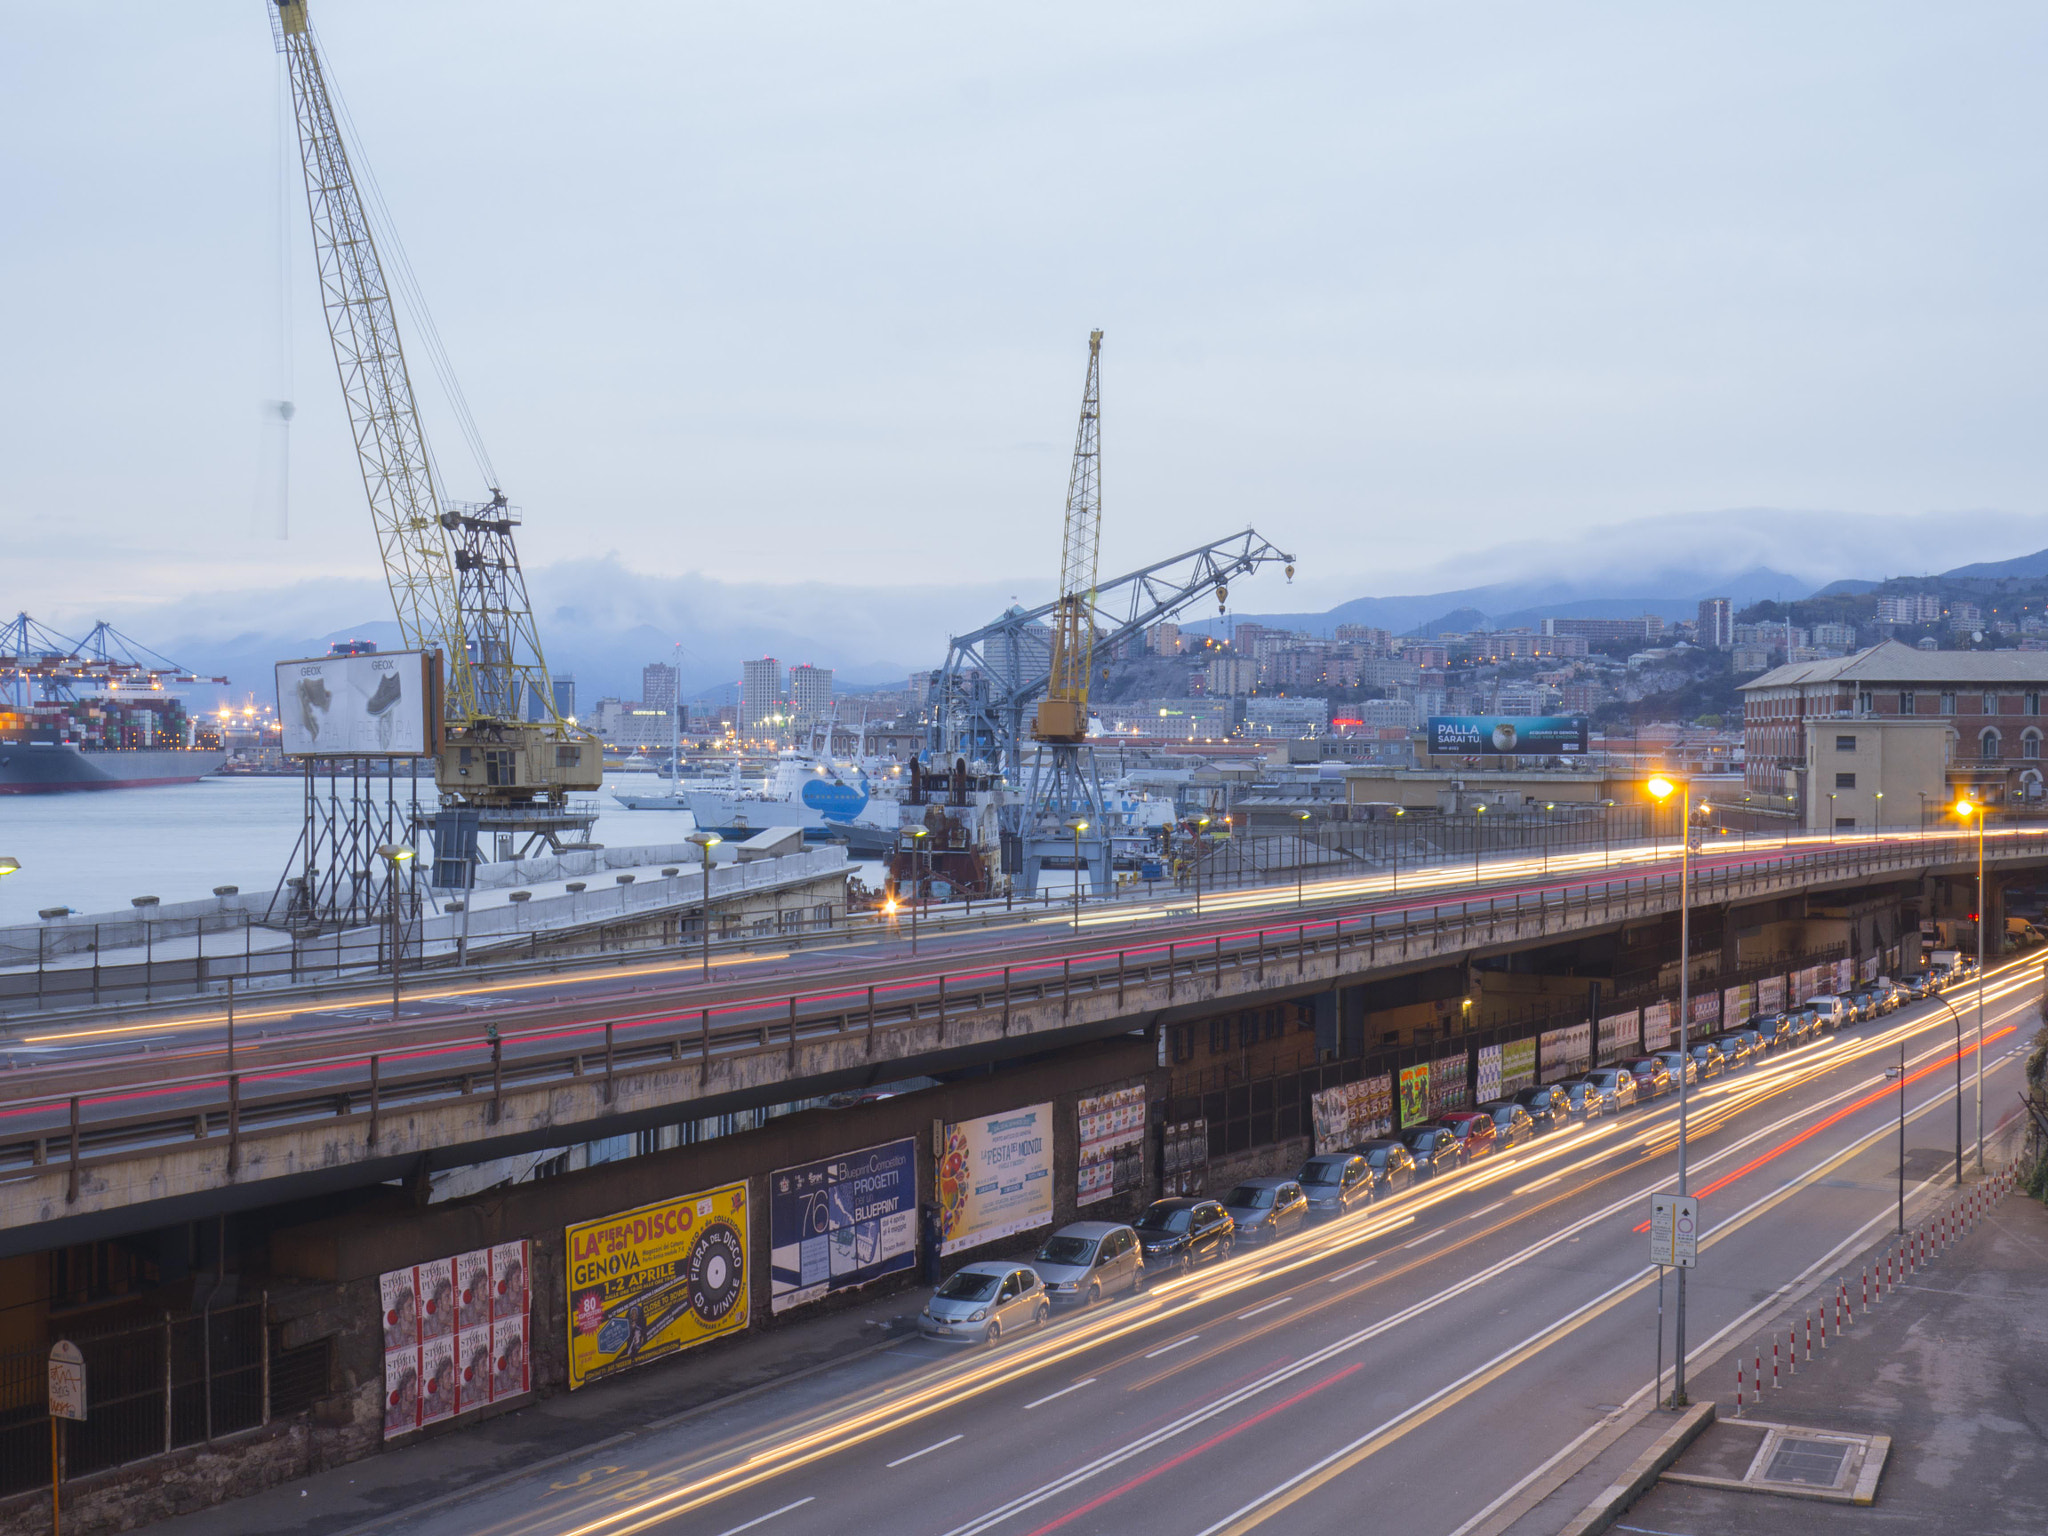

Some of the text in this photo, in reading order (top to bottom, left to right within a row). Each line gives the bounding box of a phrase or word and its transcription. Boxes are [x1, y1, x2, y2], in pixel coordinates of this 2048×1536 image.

[301, 666, 322, 677] GEOX
[372, 660, 394, 670] GEOX
[1438, 725, 1479, 734] PALLA
[987, 1145, 1010, 1165] FESTA
[1018, 1137, 1042, 1157] MONDI
[854, 1171, 898, 1195] PROGETTI
[798, 1189, 829, 1237] 76
[855, 1197, 899, 1222] BLUEPRINT
[574, 1232, 599, 1261] LA
[597, 1223, 633, 1244] FIERA
[634, 1207, 693, 1244] DISCO
[574, 1251, 640, 1285] GENOVA
[690, 1231, 742, 1281] FIERA DEL DISCO
[604, 1263, 675, 1294] 1-2 APRILE
[583, 1297, 596, 1312] 80
[713, 1278, 740, 1316] VINILE
